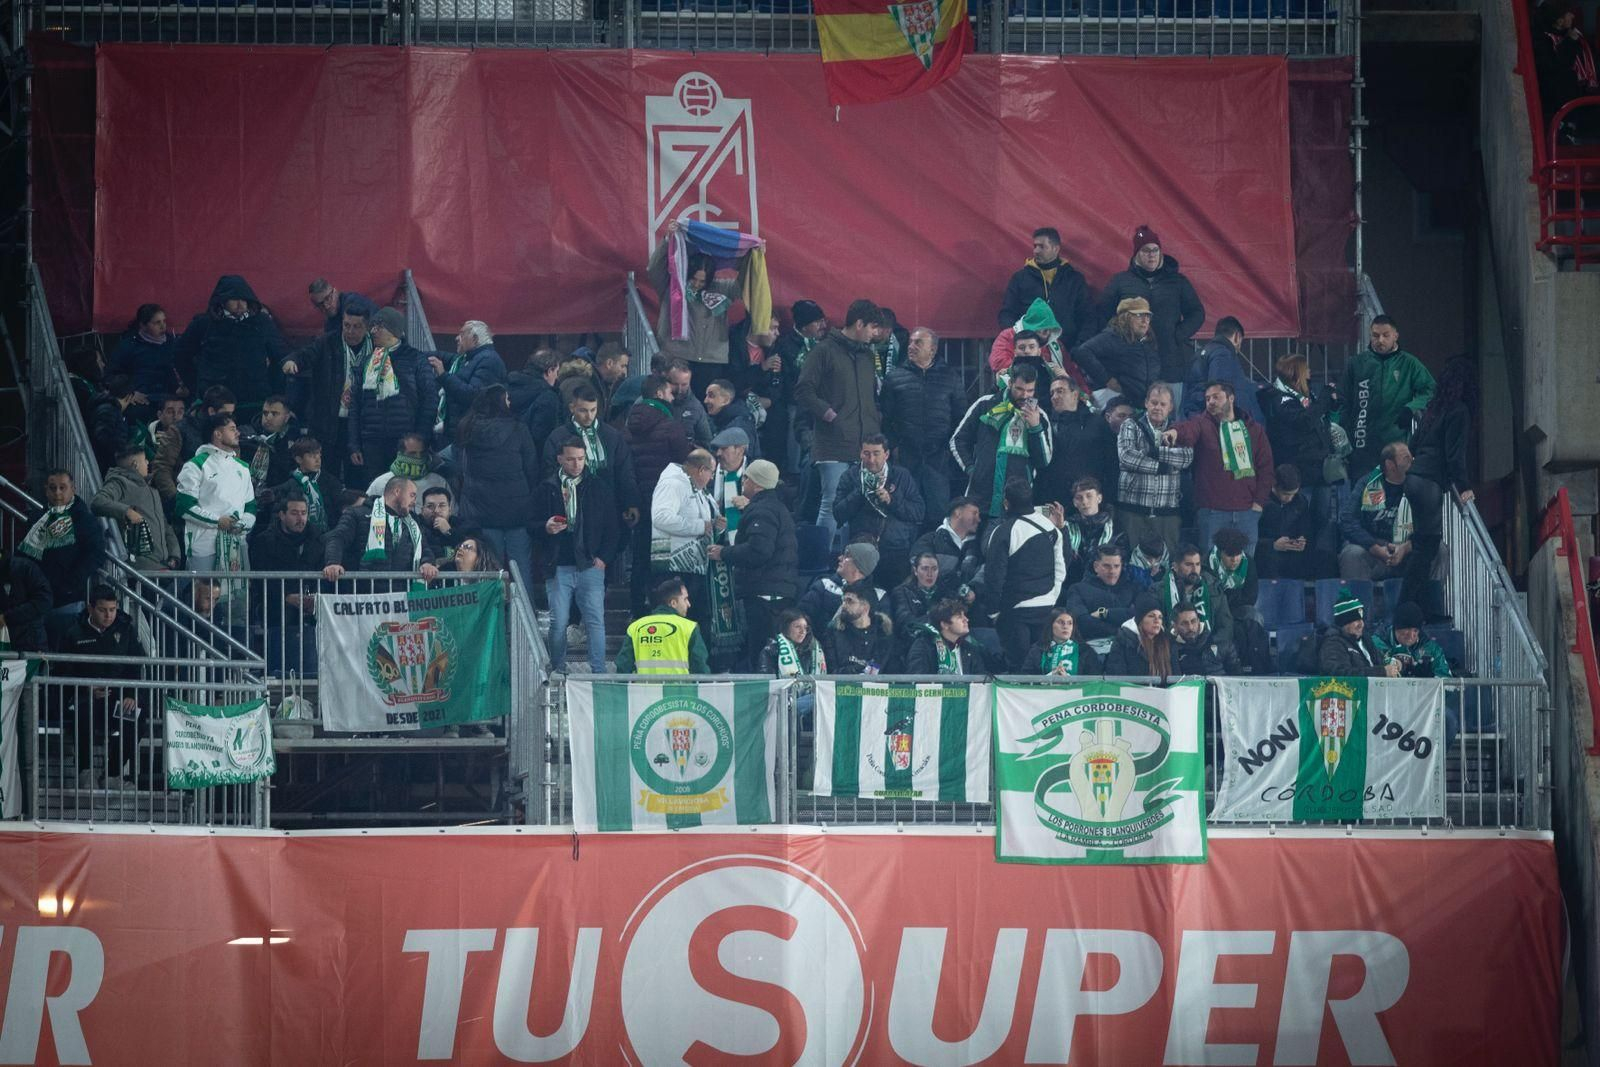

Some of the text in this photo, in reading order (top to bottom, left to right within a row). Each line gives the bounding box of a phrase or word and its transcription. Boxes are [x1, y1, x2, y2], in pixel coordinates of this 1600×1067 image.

[1355, 379, 1370, 448] CÓRDOBA
[333, 591, 480, 616] CALIFATO BLANQUIVERDE
[640, 635, 662, 644] RIS
[651, 649, 662, 657] 25
[386, 709, 446, 725] DESDE 2021
[1074, 702, 1161, 726] CORDOBESISTA
[1372, 713, 1432, 759] 1960
[1261, 781, 1395, 803] CÓRDOBA
[1048, 811, 1165, 836] LOS PORRONES BLANQUIVERDES
